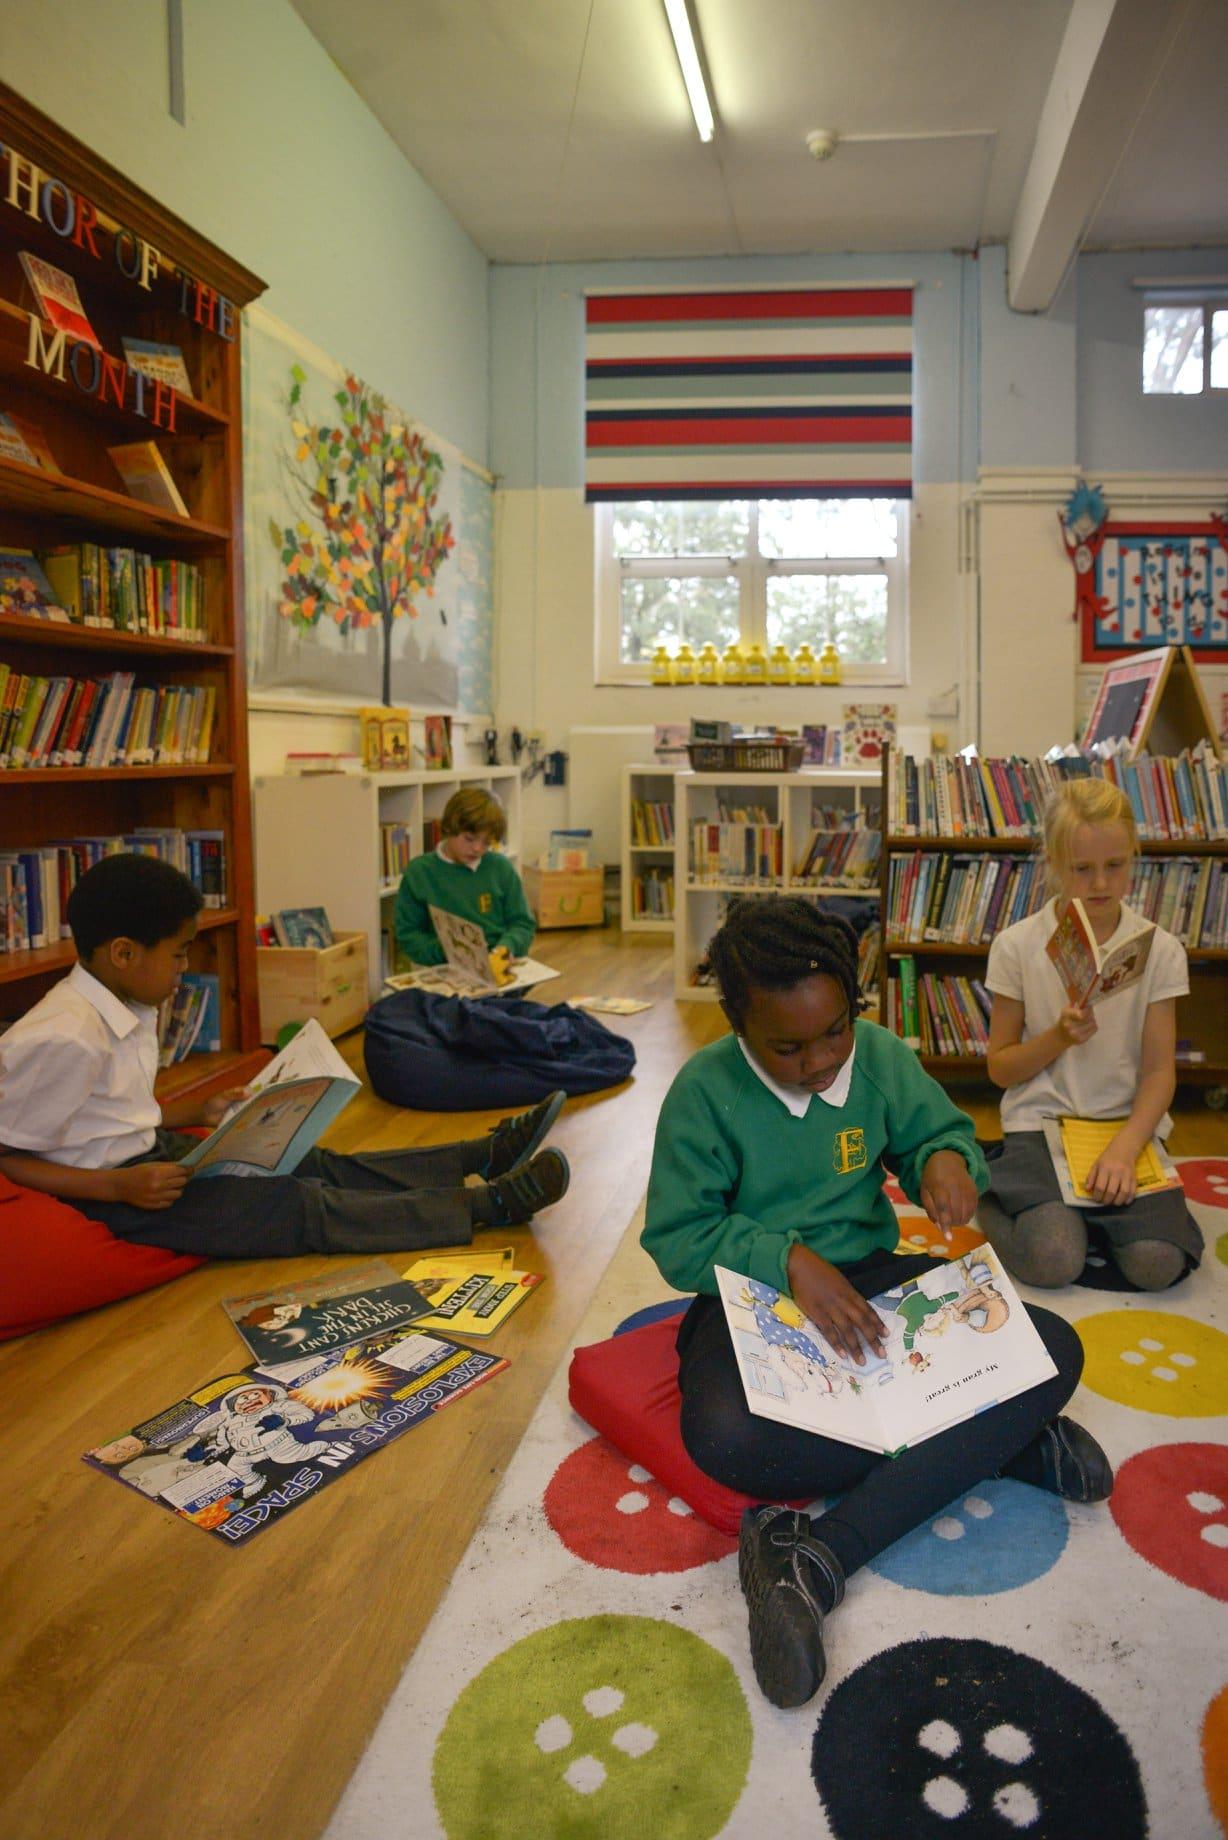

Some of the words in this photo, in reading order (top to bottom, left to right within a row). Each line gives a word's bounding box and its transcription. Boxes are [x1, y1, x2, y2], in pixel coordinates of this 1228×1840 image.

[0, 144, 101, 260] HOR
[115, 229, 161, 291] OF
[173, 266, 235, 342] THE
[24, 311, 177, 433] MONTH
[833, 1127, 867, 1174] E
[311, 1297, 374, 1324] DARK
[344, 1303, 411, 1338] CHICKENS
[350, 1309, 370, 1321] IN
[318, 1318, 347, 1334] THE
[962, 1369, 983, 1383] gran
[985, 1364, 999, 1372] My
[349, 1354, 495, 1445] EXPLOSIONS
[925, 1384, 951, 1403] great!
[317, 1441, 356, 1468] IN
[215, 1466, 324, 1540] SPACE!
